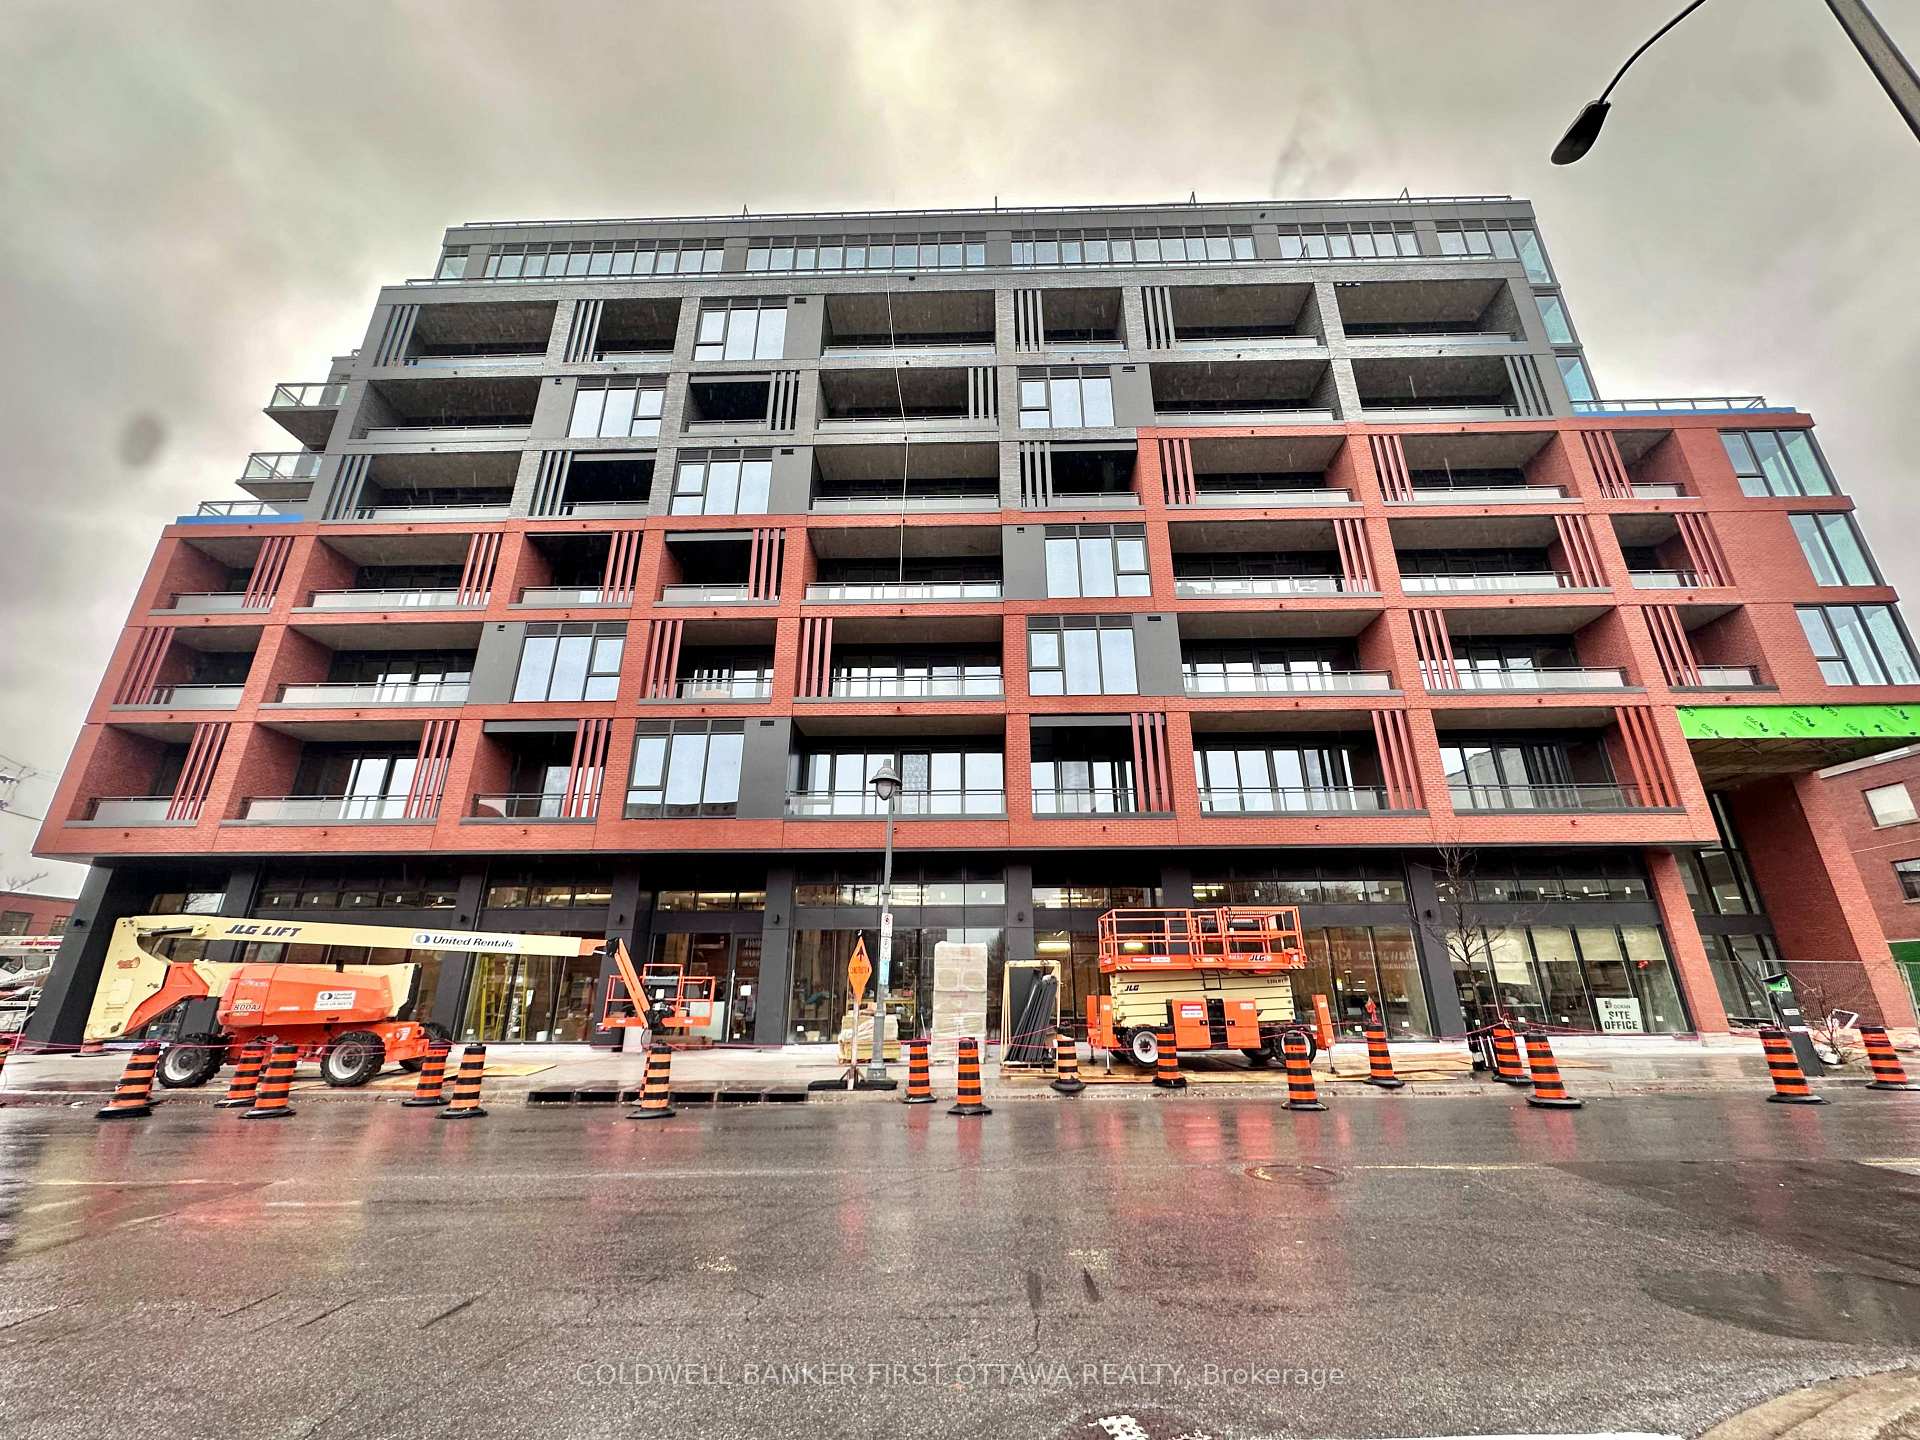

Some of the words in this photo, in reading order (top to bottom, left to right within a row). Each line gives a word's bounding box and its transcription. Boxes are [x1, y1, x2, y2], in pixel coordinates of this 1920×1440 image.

[225, 924, 261, 934] JLG
[261, 926, 302, 937] LIFT
[433, 936, 470, 946] United
[473, 938, 513, 948] Rentals
[1124, 984, 1140, 992] JLG
[1608, 1010, 1631, 1020] SITE
[1604, 1020, 1639, 1030] OFFICE
